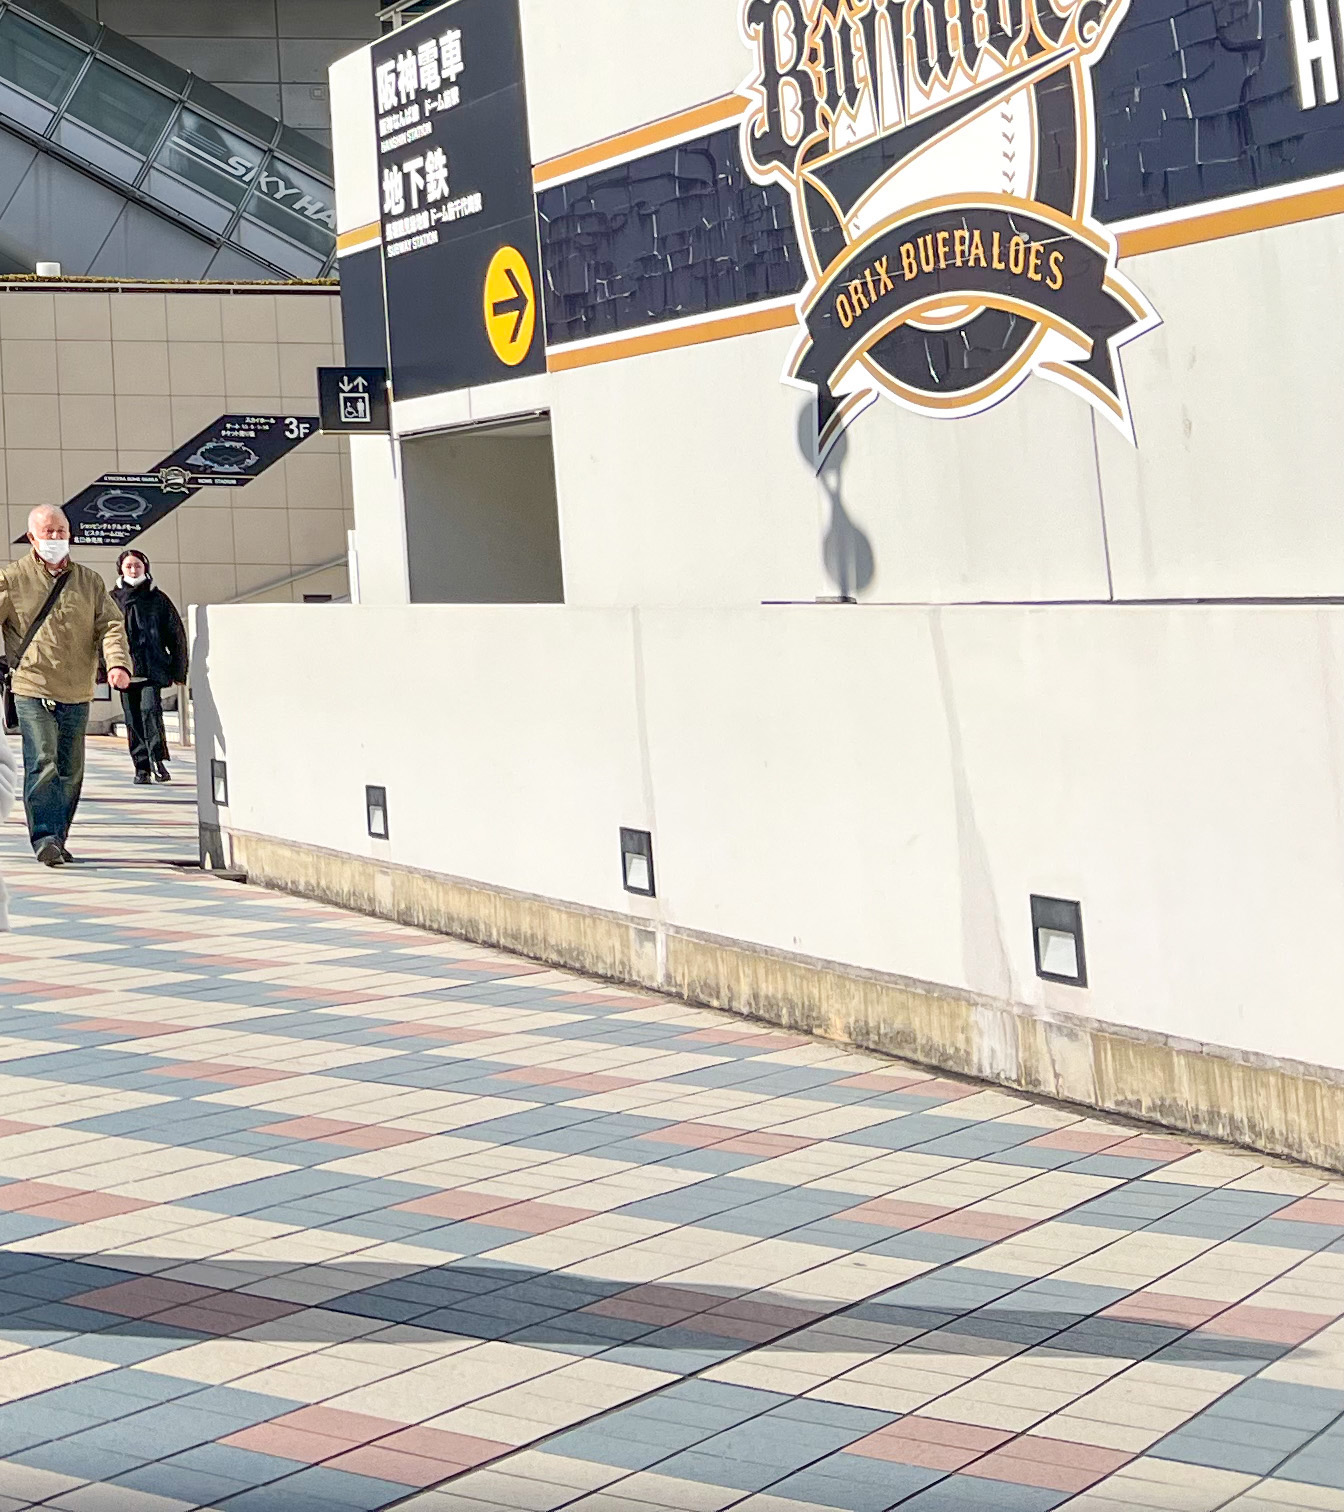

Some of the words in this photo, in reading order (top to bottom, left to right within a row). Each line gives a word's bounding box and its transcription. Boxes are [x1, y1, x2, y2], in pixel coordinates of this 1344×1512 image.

[376, 29, 464, 115] 阪神電車
[227, 155, 302, 200] SKY
[383, 146, 450, 216] 地下鉄
[835, 254, 895, 329] ORIX
[899, 229, 1064, 290] BUFFALOES
[283, 417, 310, 439] 3F
